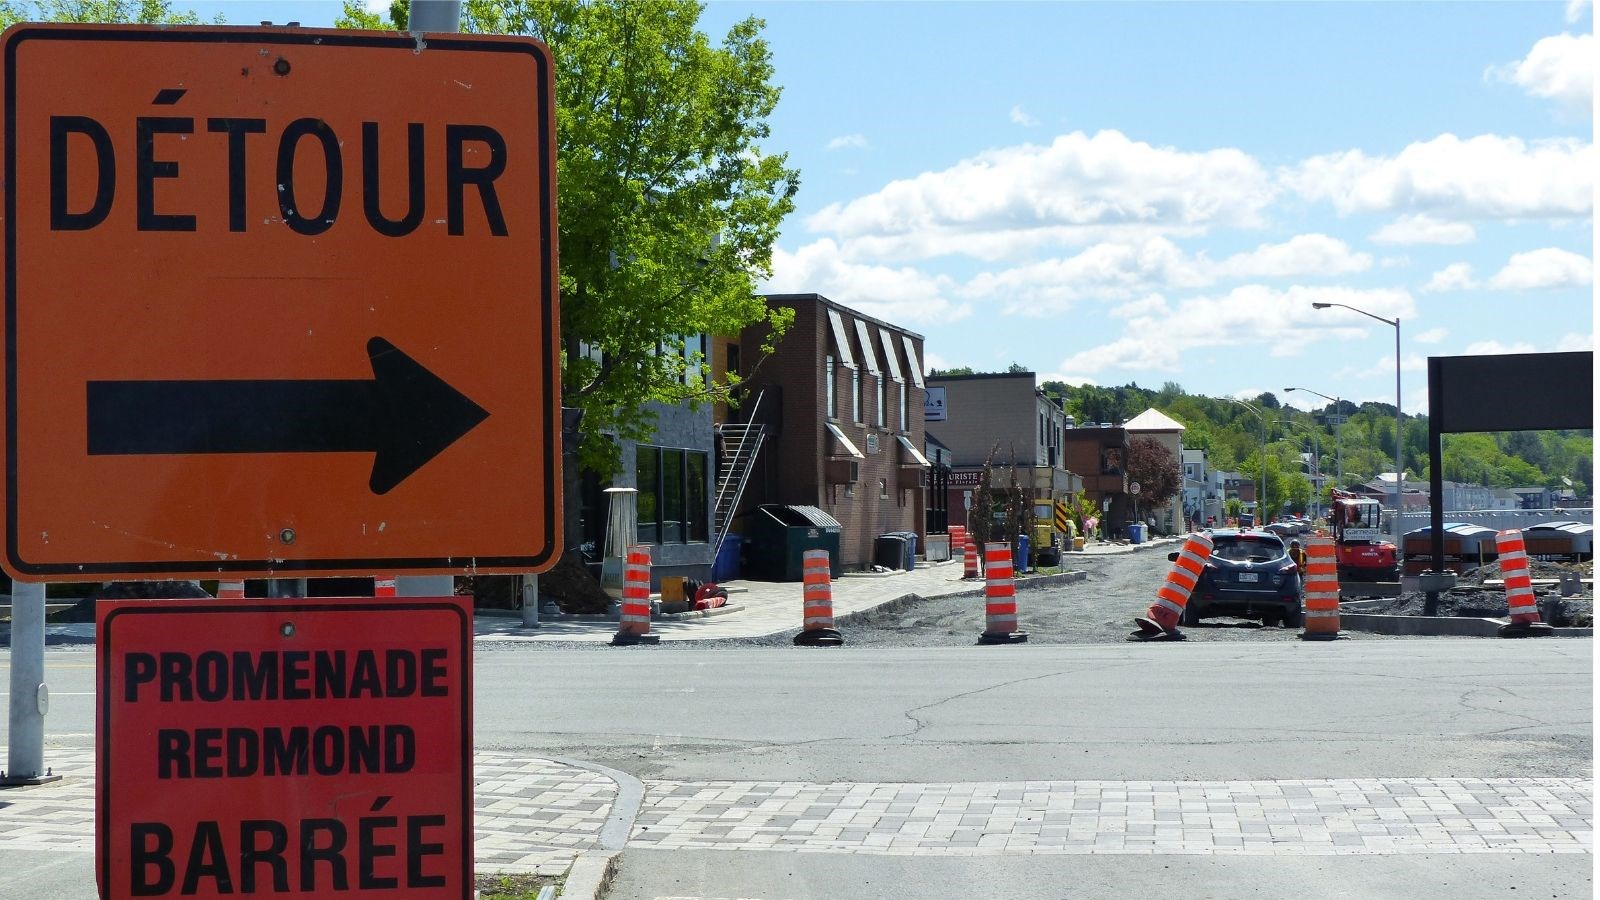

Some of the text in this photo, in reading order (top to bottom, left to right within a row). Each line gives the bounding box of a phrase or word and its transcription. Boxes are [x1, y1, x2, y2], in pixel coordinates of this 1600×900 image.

[49, 89, 509, 237] DÉTOUR
[124, 648, 449, 702] PROMENADE
[158, 724, 416, 779] REDMOND
[130, 796, 447, 896] BARRÉE
